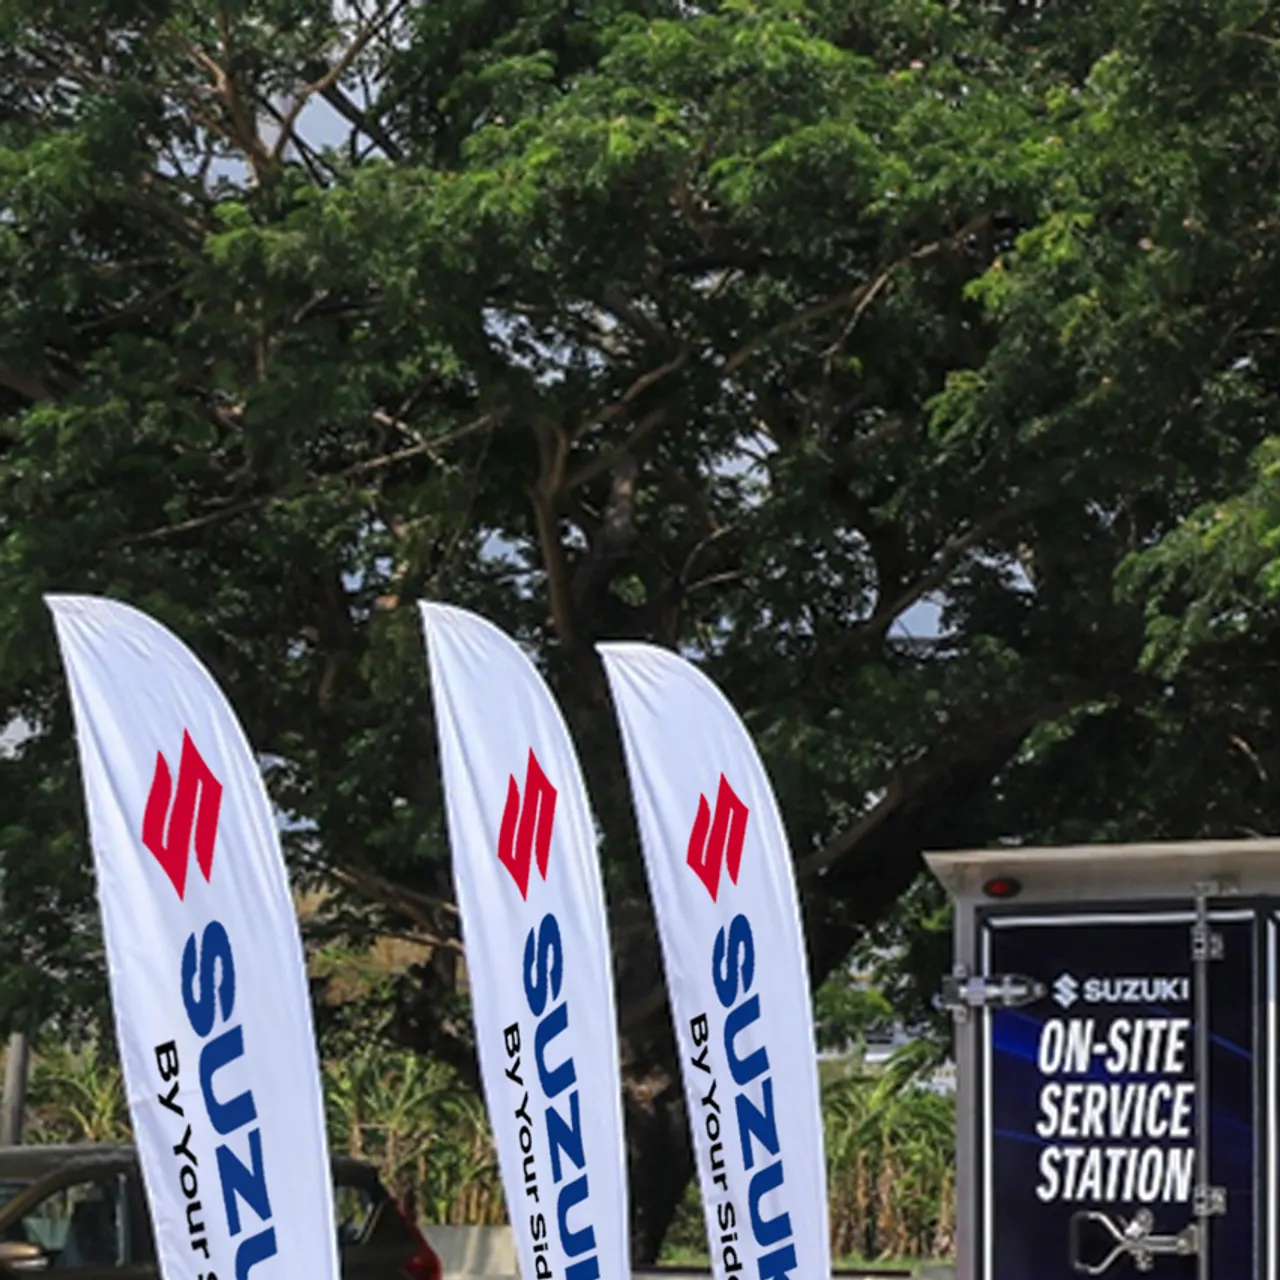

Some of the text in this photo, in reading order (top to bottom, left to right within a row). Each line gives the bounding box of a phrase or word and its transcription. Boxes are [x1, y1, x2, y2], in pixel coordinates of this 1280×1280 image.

[1083, 978, 1189, 1002] SUZUKI
[1038, 1017, 1190, 1074] ON-SITE
[503, 1022, 524, 1086] By
[514, 1092, 540, 1203] Your
[691, 1013, 711, 1074] By
[701, 1080, 728, 1191] Your
[1036, 1081, 1196, 1138] SERVICE
[154, 1040, 184, 1117] By
[173, 1124, 210, 1259] Your
[1036, 1145, 1195, 1202] STATION
